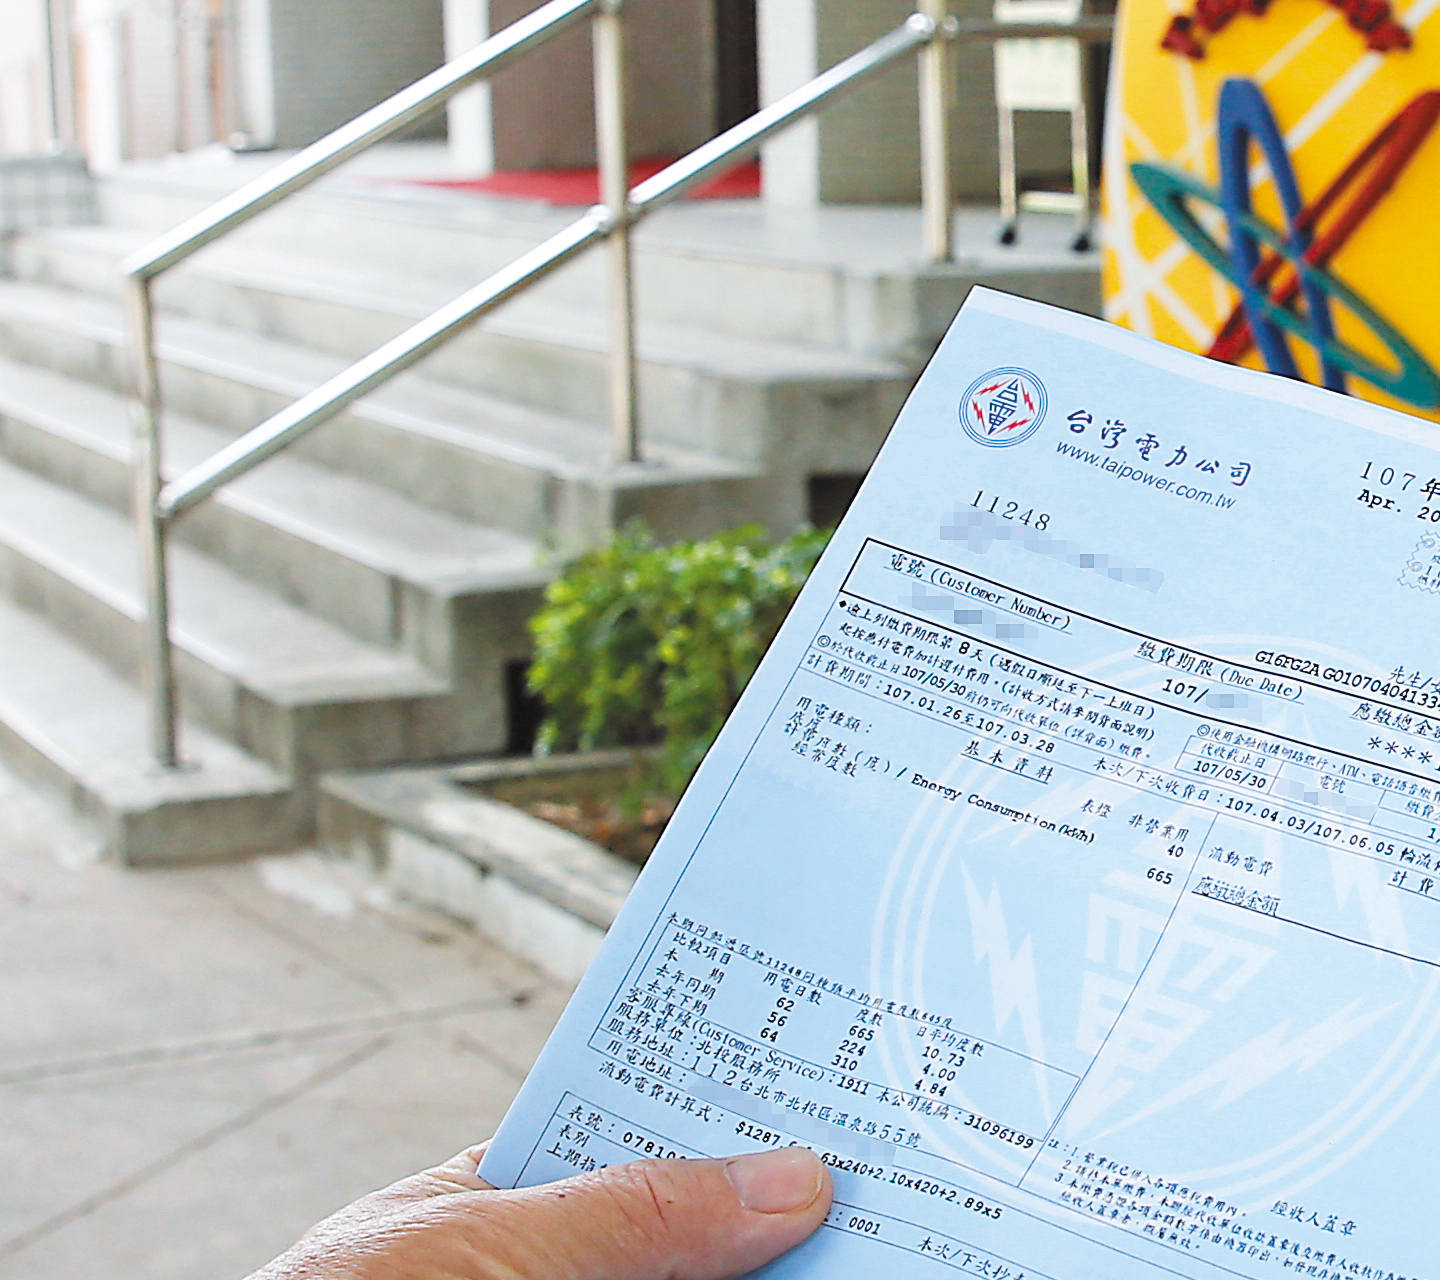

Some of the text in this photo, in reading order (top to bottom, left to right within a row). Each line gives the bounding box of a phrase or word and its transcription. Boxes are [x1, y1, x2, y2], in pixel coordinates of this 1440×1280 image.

[1058, 406, 1255, 487] 台灣電力公司
[1052, 440, 1237, 510] www.taipower.com.tw
[969, 489, 1053, 531] 11248
[1354, 488, 1407, 515] Apr.
[926, 567, 1008, 605] (Customer
[1008, 596, 1074, 631] Number)
[1218, 664, 1259, 689] (Due
[1257, 676, 1305, 702] Date)
[909, 773, 963, 801] Energy
[1192, 758, 1267, 790] 107/05/30
[1166, 844, 1184, 858] 40
[1145, 867, 1174, 885] 665
[766, 1011, 788, 1027] 56
[838, 1039, 866, 1057] 224
[921, 1062, 957, 1083] 4.00
[774, 996, 796, 1012] 62
[847, 1024, 875, 1042] 665
[921, 1045, 965, 1069] 10.73
[758, 1026, 780, 1043] 64
[830, 1054, 859, 1072] 310
[913, 1077, 947, 1098] 4.84
[847, 1215, 882, 1235] 0001
